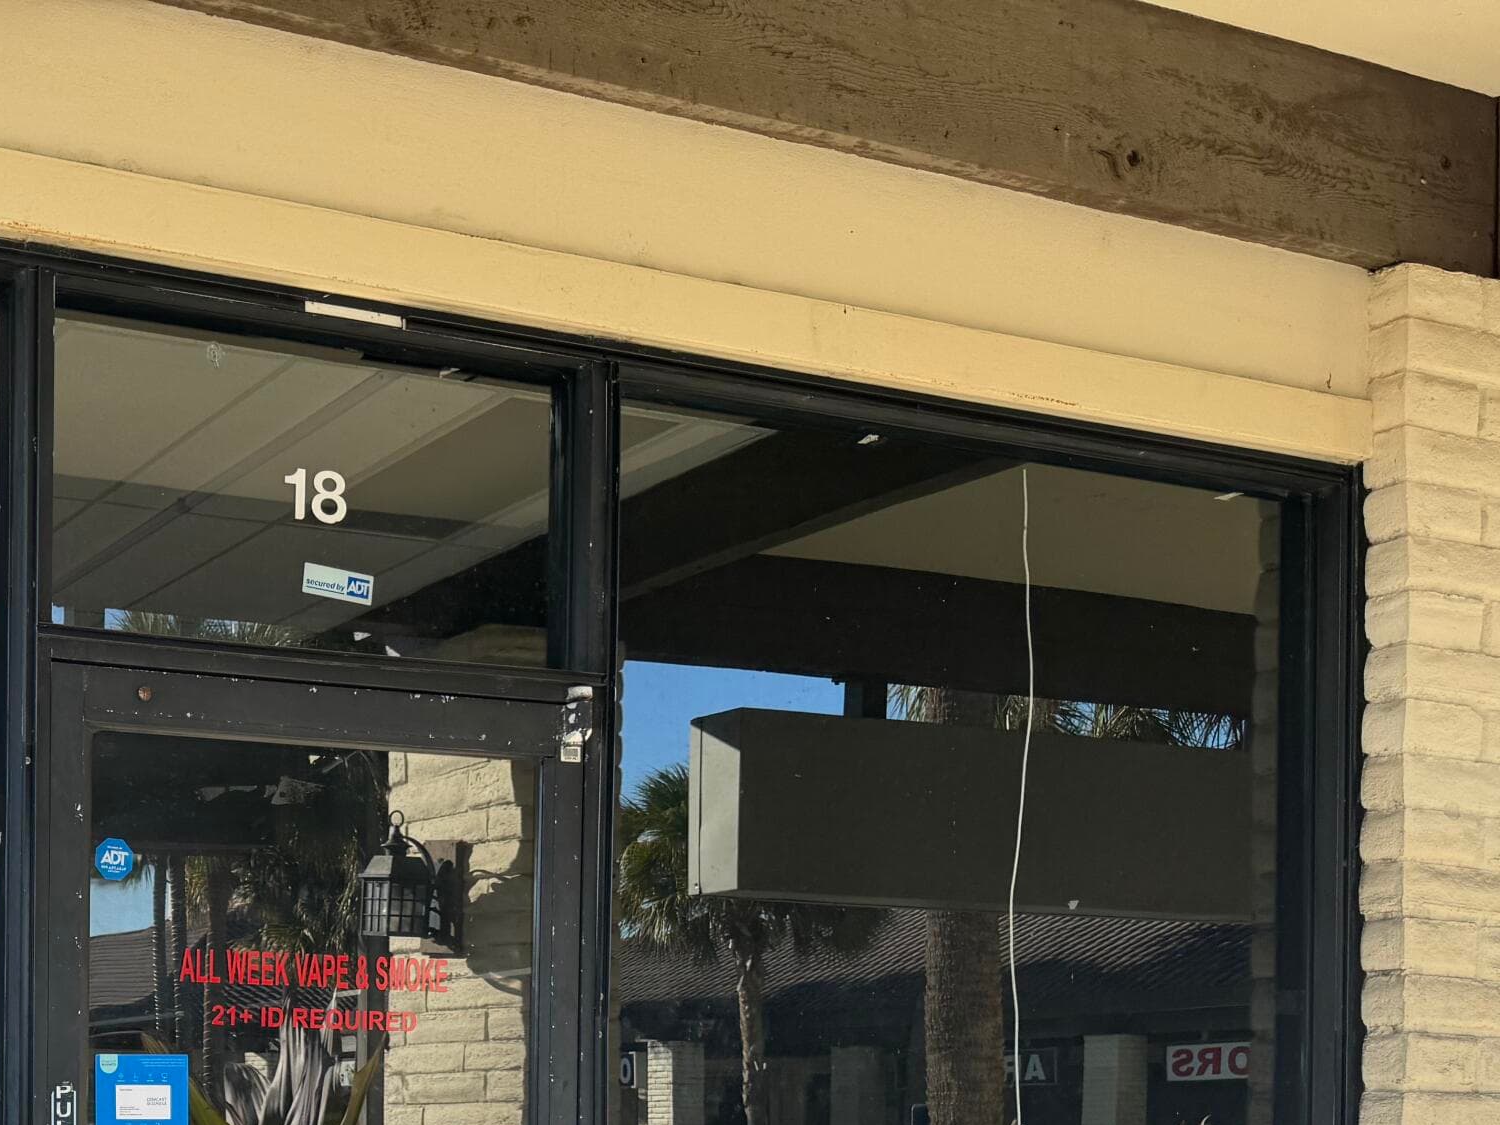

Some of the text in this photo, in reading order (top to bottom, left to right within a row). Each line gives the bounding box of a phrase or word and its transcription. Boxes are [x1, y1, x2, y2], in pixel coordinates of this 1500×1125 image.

[284, 467, 347, 525] 18
[306, 578, 370, 596] secured by ADT
[100, 850, 129, 866] ADT
[179, 947, 449, 993] ALL WEEK VAPE & SMOKE
[211, 1005, 418, 1033] 21+ ID REQUIRED
